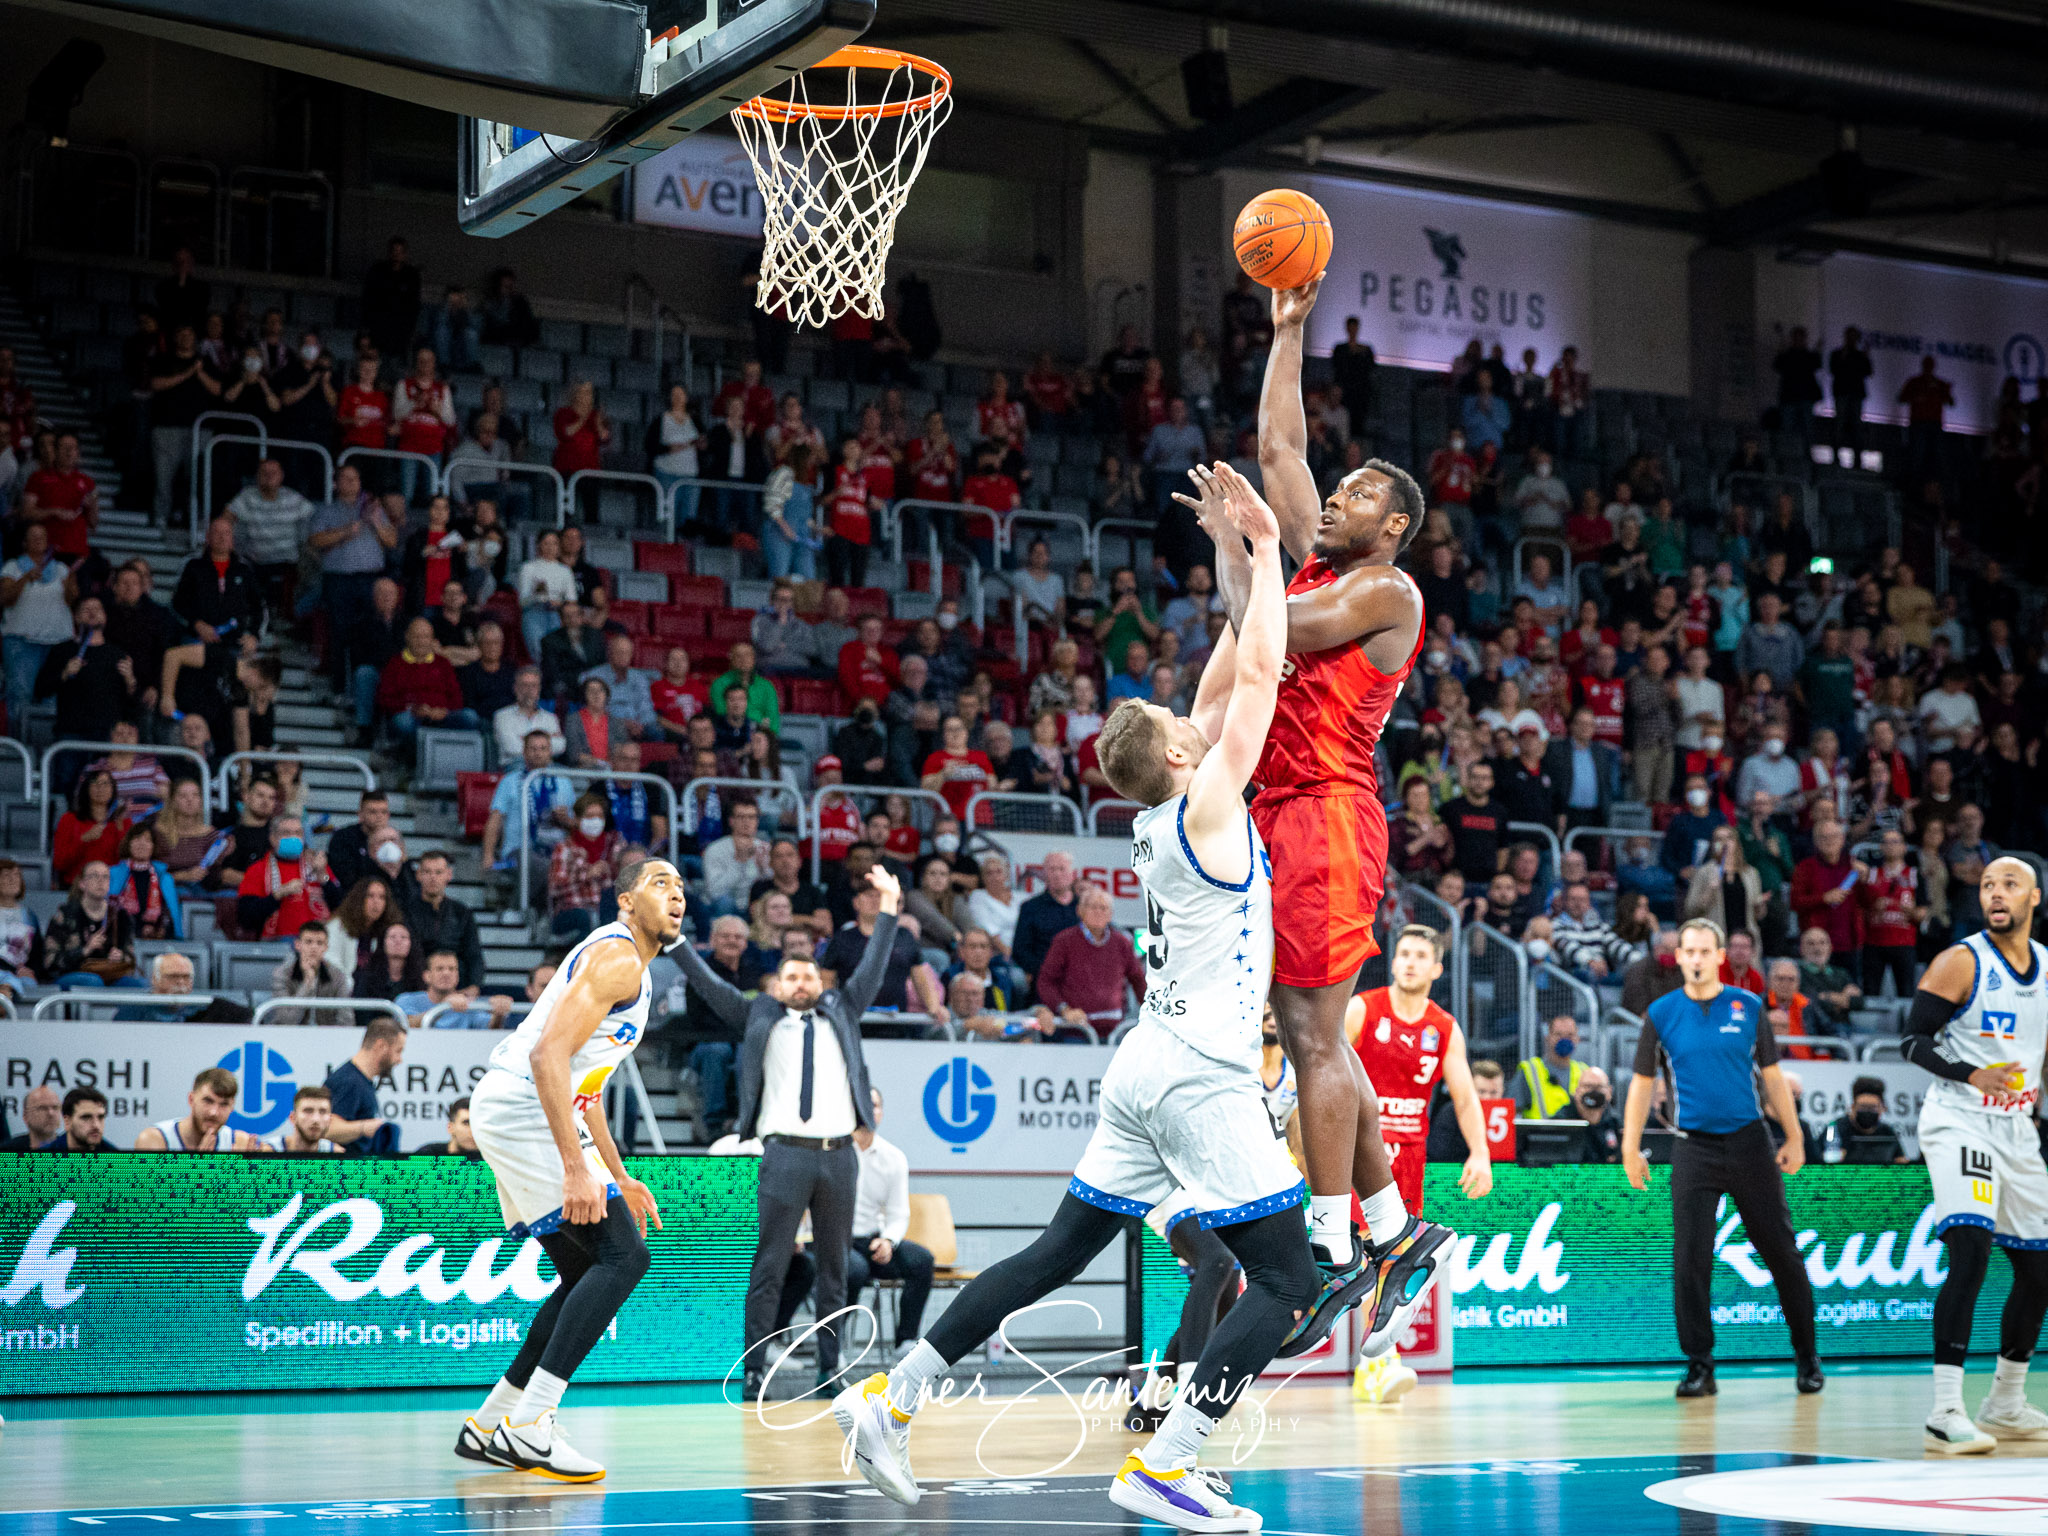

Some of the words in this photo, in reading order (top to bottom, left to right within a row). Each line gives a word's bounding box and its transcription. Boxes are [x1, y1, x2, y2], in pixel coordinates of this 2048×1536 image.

[1359, 270, 1546, 331] PEGASUS
[6, 1057, 150, 1089] RASHI
[1019, 1111, 1100, 1129] MOTOR
[1487, 1106, 1509, 1143] 5
[241, 1191, 562, 1304] Rau
[1497, 1304, 1568, 1328] GmbH
[1710, 1301, 1786, 1324] edition
[1815, 1301, 1879, 1327] ogistik
[1885, 1298, 1934, 1321] Gmb
[244, 1321, 382, 1353] Spedition
[420, 1319, 521, 1350] Logistik
